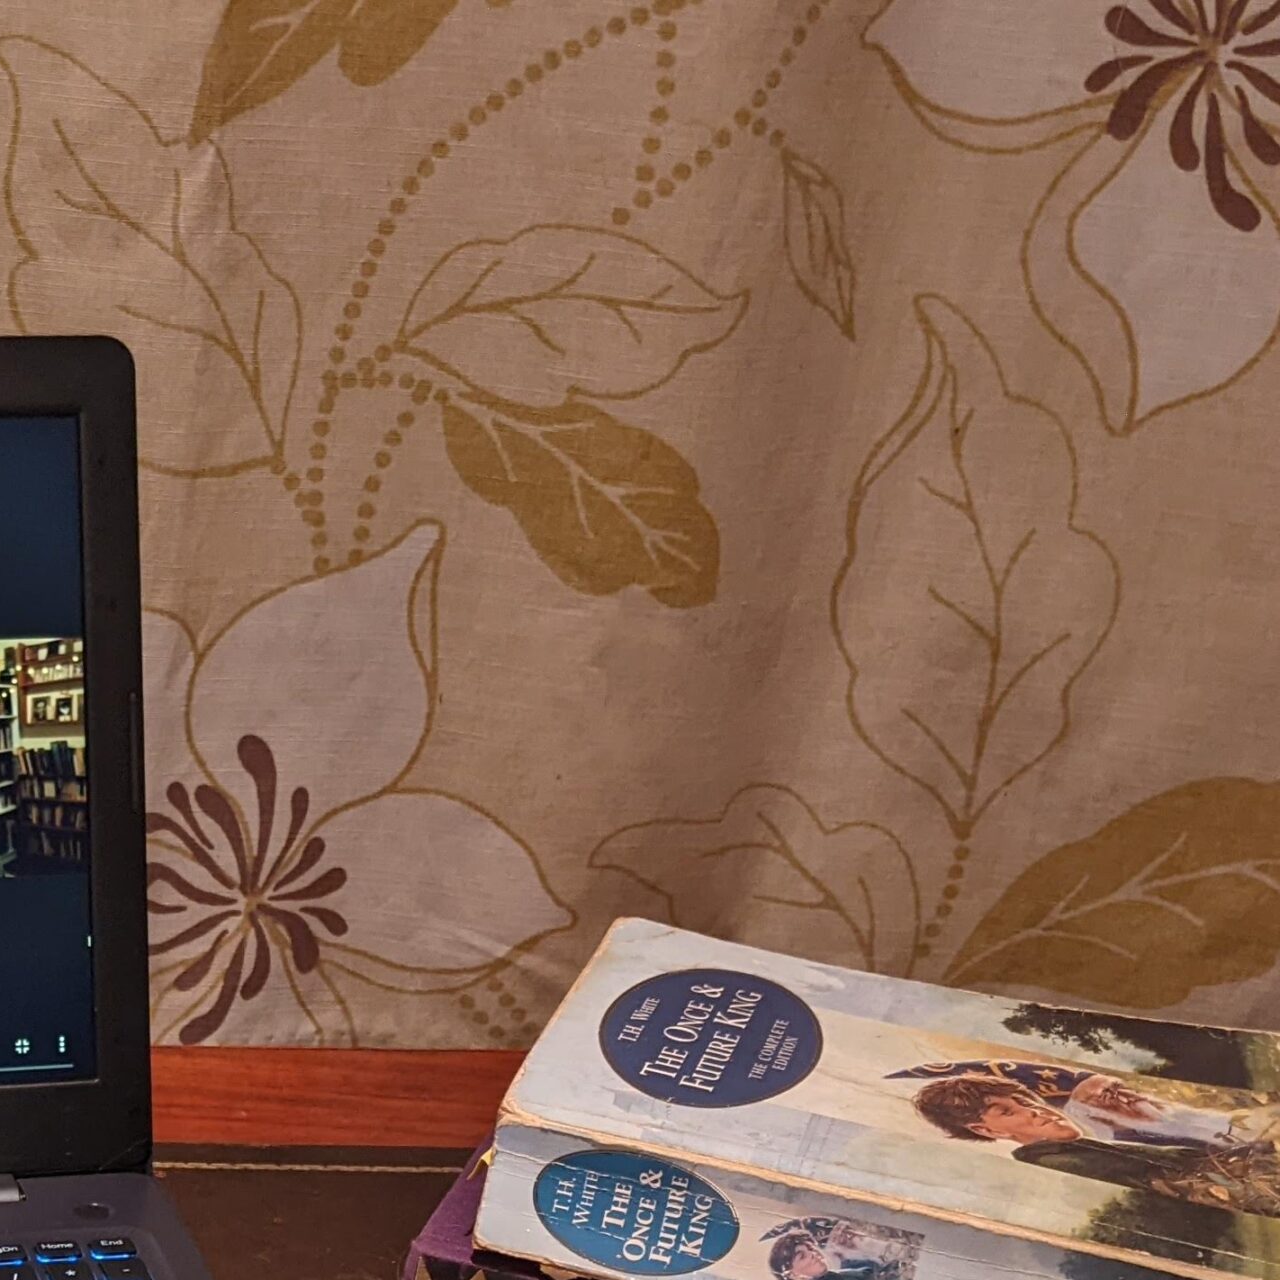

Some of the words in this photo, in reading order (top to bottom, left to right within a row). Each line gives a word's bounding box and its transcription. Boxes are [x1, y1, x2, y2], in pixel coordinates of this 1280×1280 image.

[690, 983, 725, 999] &
[618, 1024, 645, 1043] T.H.
[748, 1060, 767, 1081] THE
[762, 1018, 790, 1064] COMPLETE
[771, 1034, 799, 1071] EDITION
[639, 1169, 664, 1189] &
[552, 1176, 577, 1213] T.H.
[41, 1241, 74, 1250] Home
[100, 1239, 124, 1247] End
